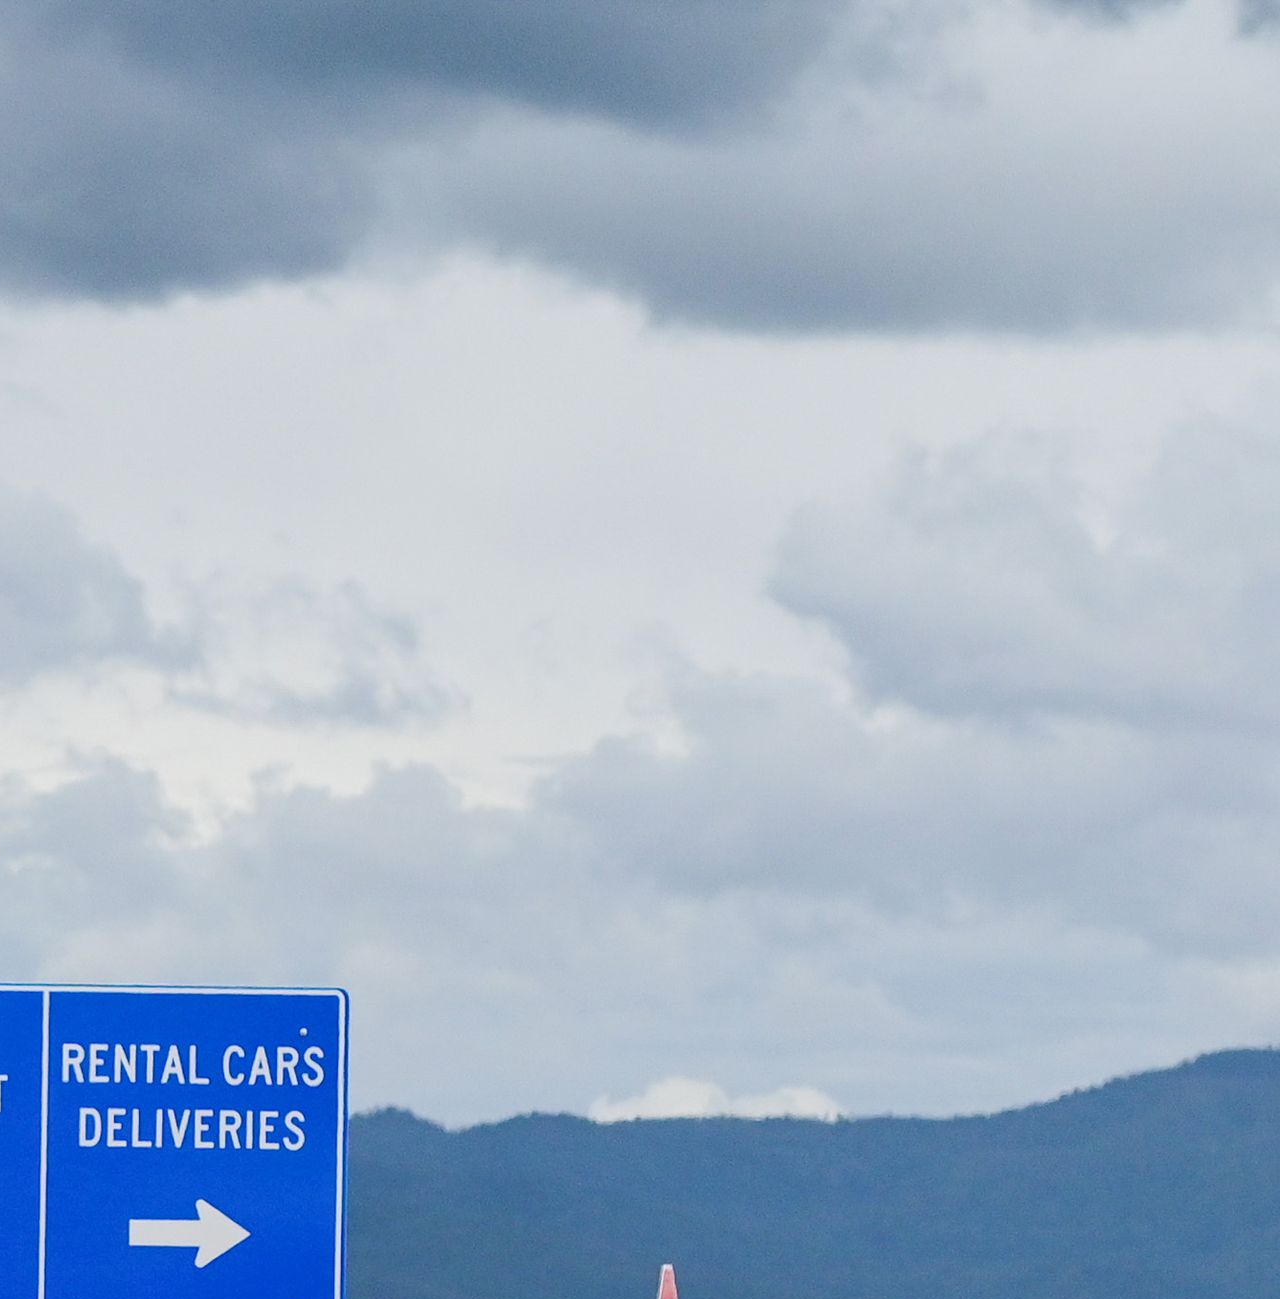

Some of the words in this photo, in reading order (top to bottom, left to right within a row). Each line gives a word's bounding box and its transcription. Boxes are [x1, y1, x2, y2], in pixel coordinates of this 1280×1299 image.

[62, 1043, 210, 1085] RENTAL
[223, 1045, 325, 1087] CARS
[79, 1107, 306, 1151] DELIVERIES
